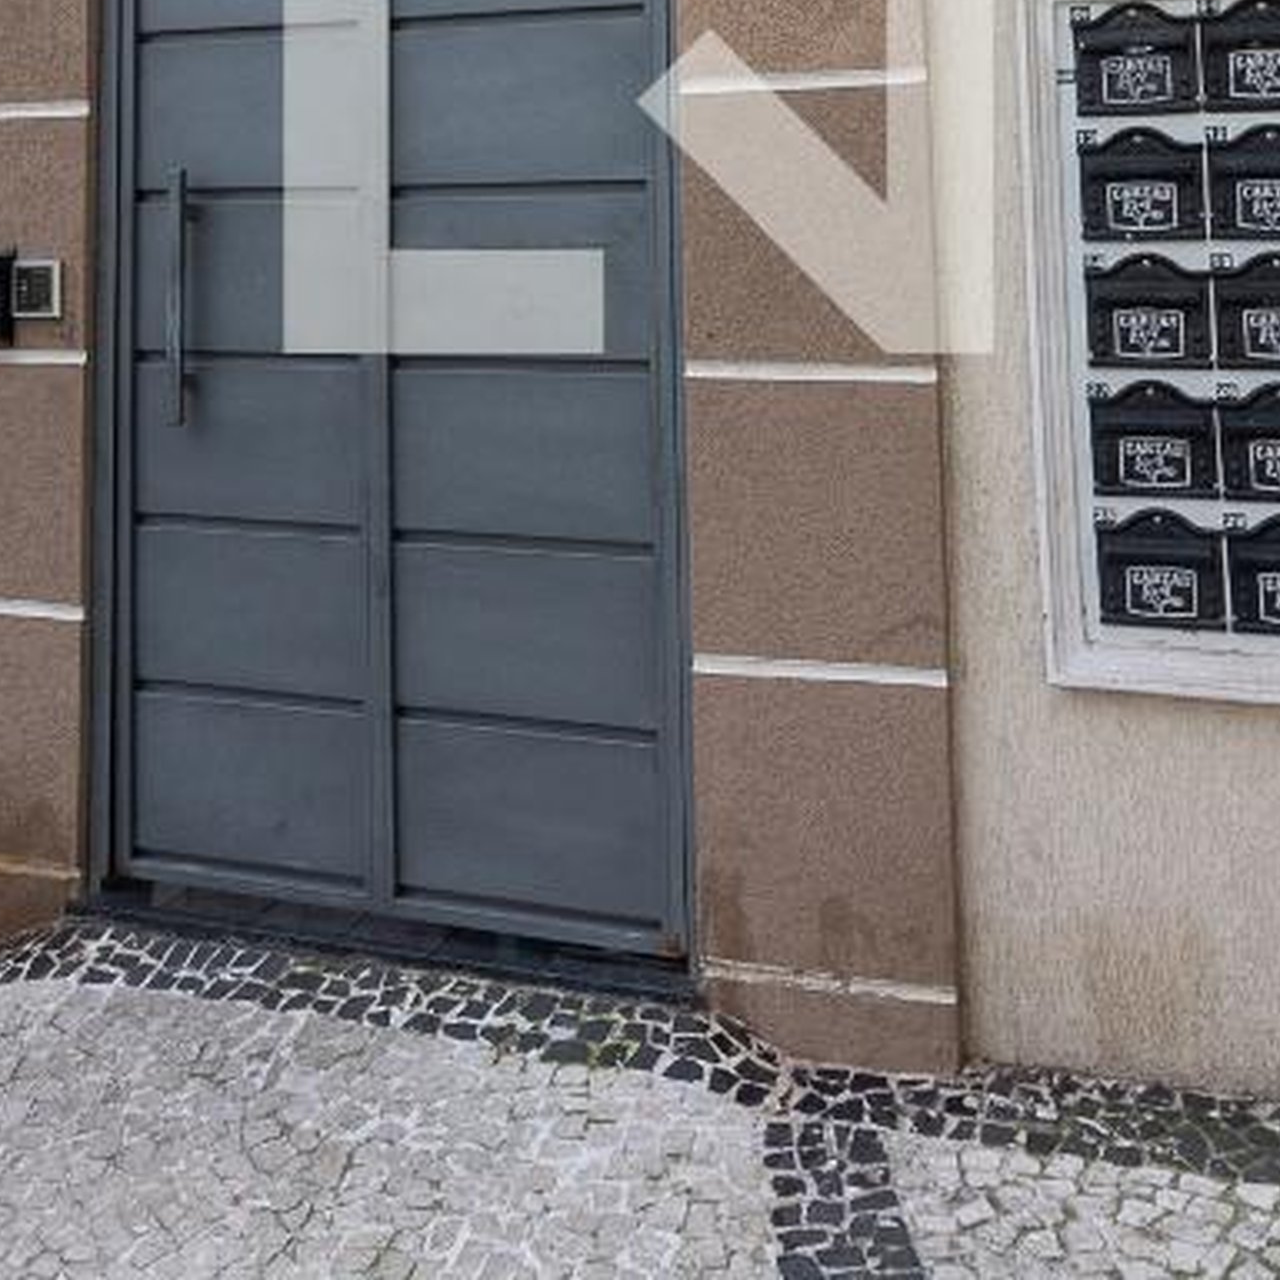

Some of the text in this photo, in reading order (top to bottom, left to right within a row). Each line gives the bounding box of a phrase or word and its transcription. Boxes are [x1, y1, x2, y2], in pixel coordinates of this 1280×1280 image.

[1112, 186, 1171, 201] CARTAS
[1119, 315, 1176, 327] CARTAS
[1125, 442, 1184, 457] CARTAS
[1131, 571, 1192, 586] CARTAS
